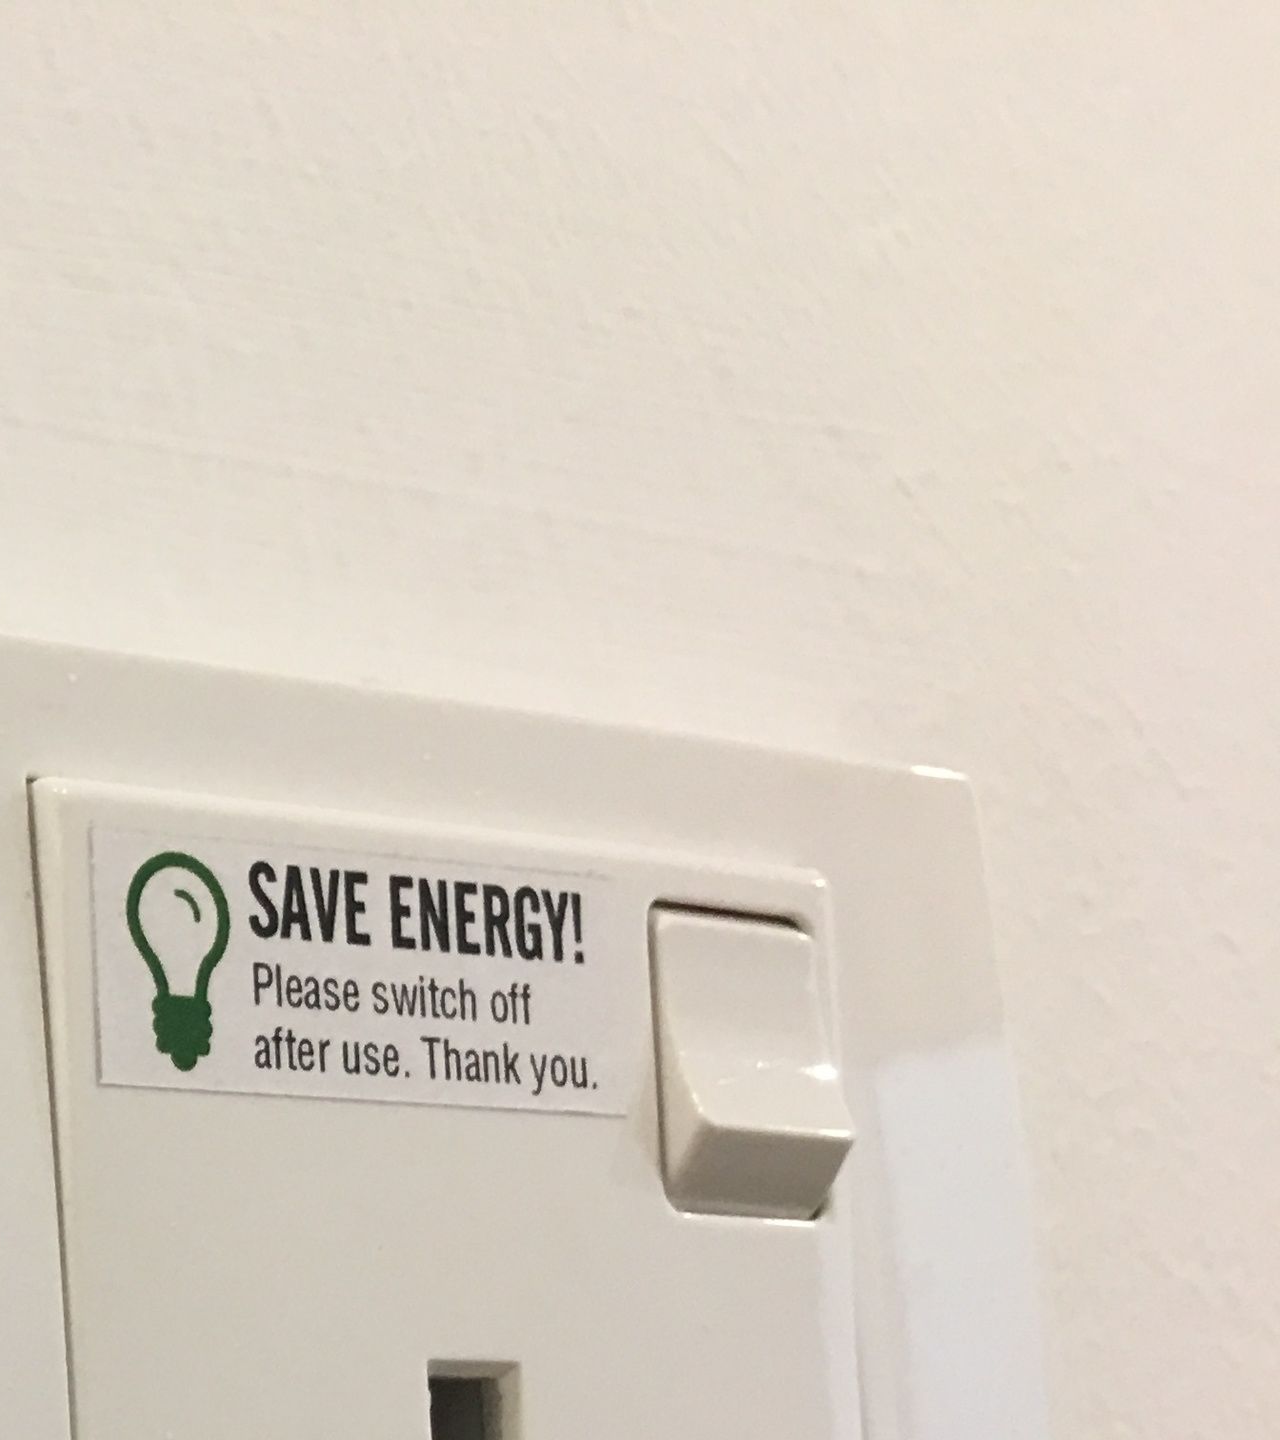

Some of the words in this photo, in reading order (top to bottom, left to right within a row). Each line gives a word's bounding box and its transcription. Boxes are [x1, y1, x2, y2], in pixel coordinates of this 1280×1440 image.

[248, 860, 372, 947] SAVE
[389, 875, 586, 964] ENERGY!
[252, 961, 360, 1013] Please
[372, 975, 477, 1022] switch
[490, 982, 532, 1026] off
[254, 1026, 330, 1073] after
[341, 1040, 410, 1078] use.
[420, 1035, 521, 1085] Thank
[530, 1050, 600, 1097] you.
